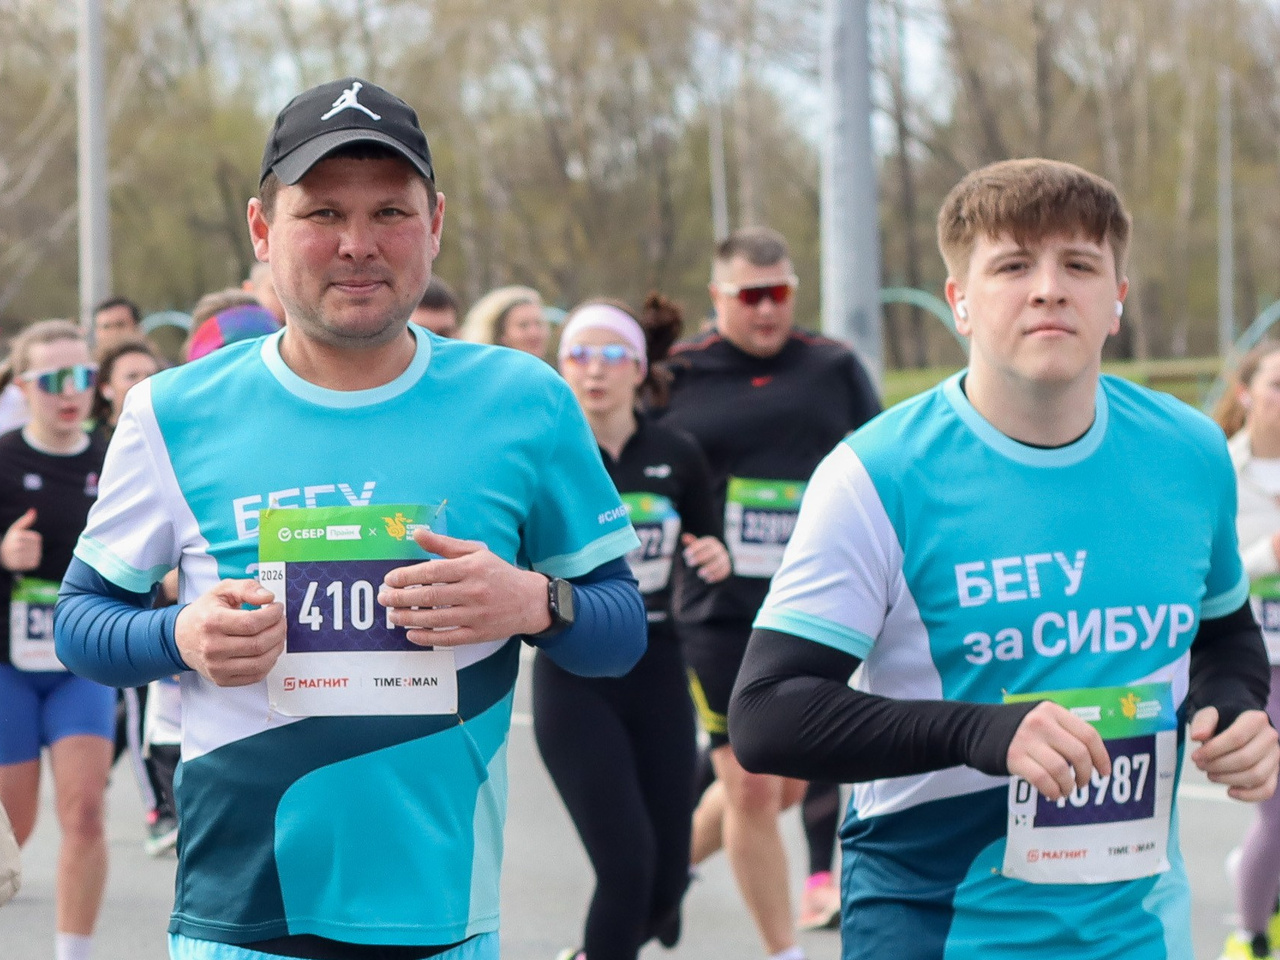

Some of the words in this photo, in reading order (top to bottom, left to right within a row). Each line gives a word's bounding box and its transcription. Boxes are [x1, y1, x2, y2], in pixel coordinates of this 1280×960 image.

[597, 503, 626, 524] #СИБ
[294, 528, 325, 539] СБЕР
[261, 570, 283, 581] 2026
[954, 550, 1087, 608] БЕГУ
[963, 628, 1024, 665] за
[1032, 604, 1195, 657] СИБУР
[298, 678, 350, 688] МАГНИТ
[1016, 779, 1033, 803] D
[1045, 753, 1151, 808] 0987
